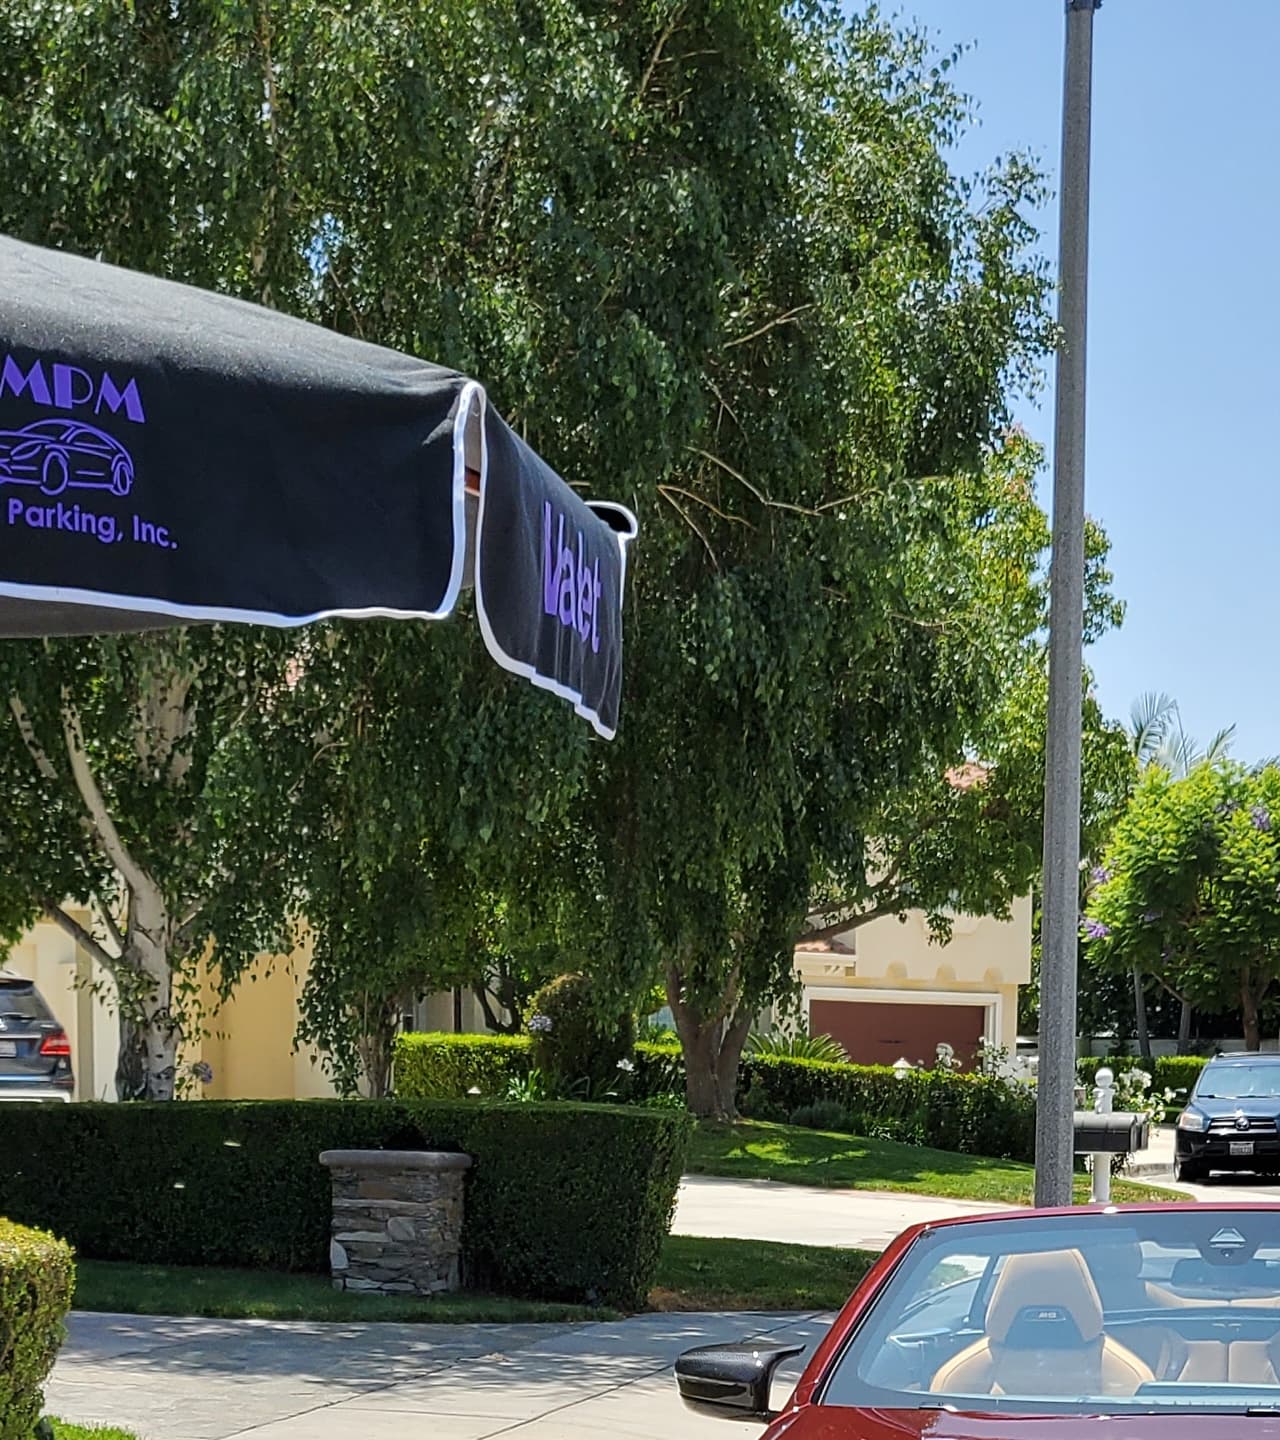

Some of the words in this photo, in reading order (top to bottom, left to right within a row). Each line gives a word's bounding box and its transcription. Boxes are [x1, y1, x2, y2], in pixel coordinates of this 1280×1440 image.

[7, 498, 124, 544] Parking,
[132, 515, 179, 550] Inc.
[543, 500, 602, 654] Valet
